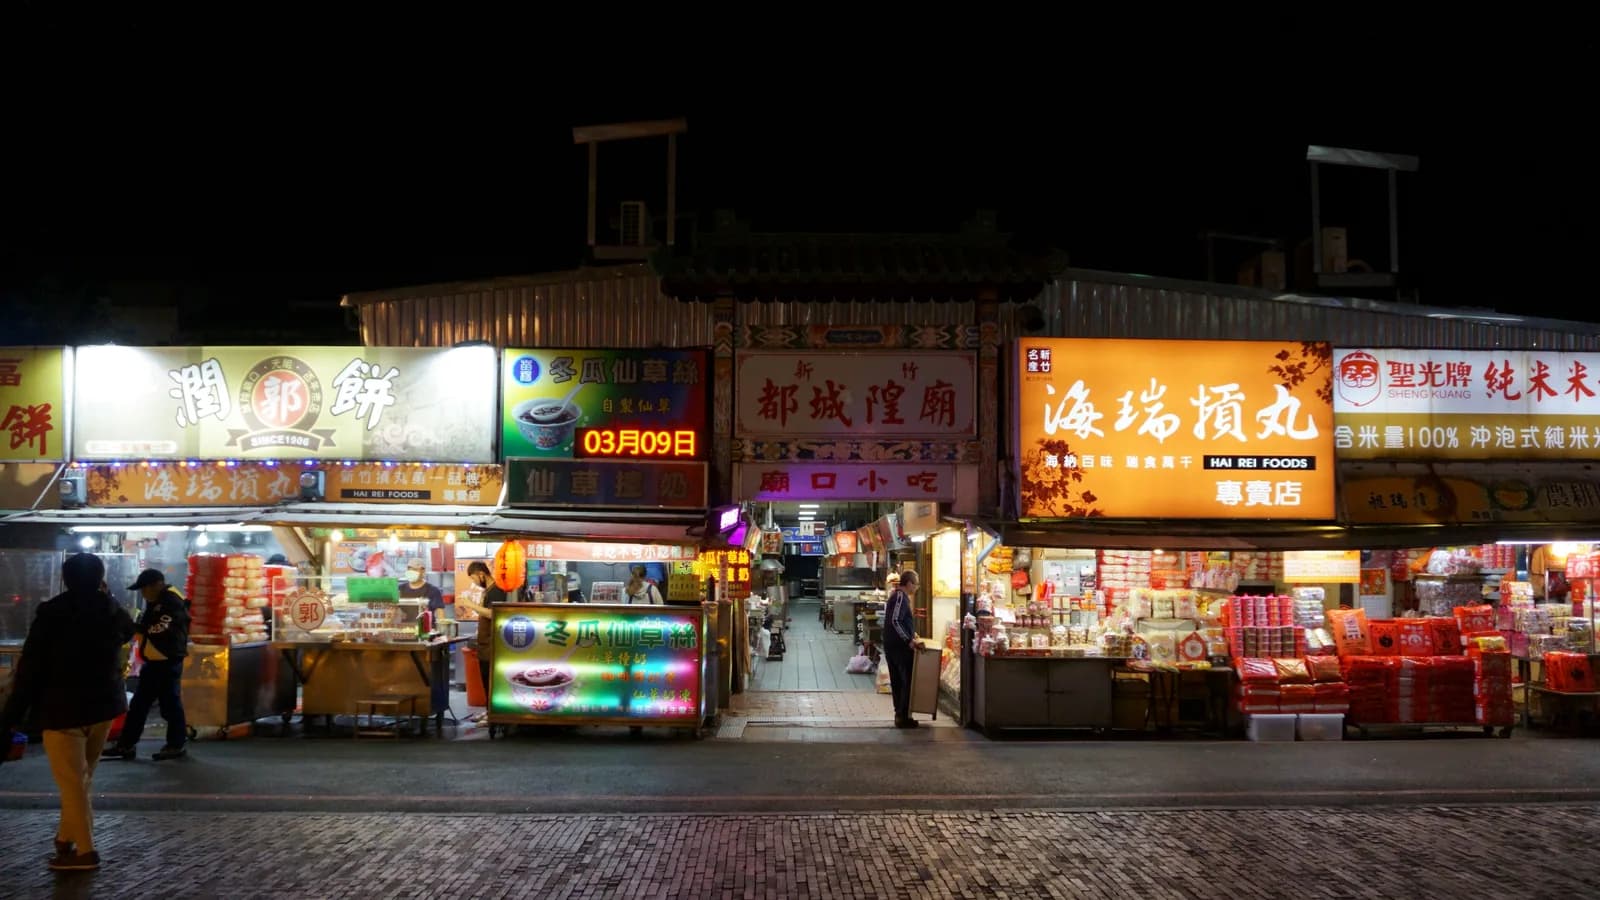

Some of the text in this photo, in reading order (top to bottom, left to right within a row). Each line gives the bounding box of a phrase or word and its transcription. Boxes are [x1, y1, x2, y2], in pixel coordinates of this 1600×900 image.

[550, 355, 698, 384] 冬瓜仙草絲
[1386, 359, 1600, 402] 聖光牌 純米米
[168, 357, 400, 431] 潤 餅
[262, 374, 302, 423] 郭
[757, 377, 956, 428] 都城隍廟
[1388, 390, 1472, 400] SHENG KUANG
[584, 429, 695, 456] 03月09日
[1334, 425, 1459, 449] 含米量100%
[1210, 458, 1308, 468] HAI REI FOODS
[353, 490, 419, 499] HAI REI FOODS
[759, 470, 939, 493] 廟口小吃
[1215, 480, 1302, 507] 專賣店
[298, 602, 320, 623] 郭
[544, 617, 698, 649] 冬瓜仙草絲
